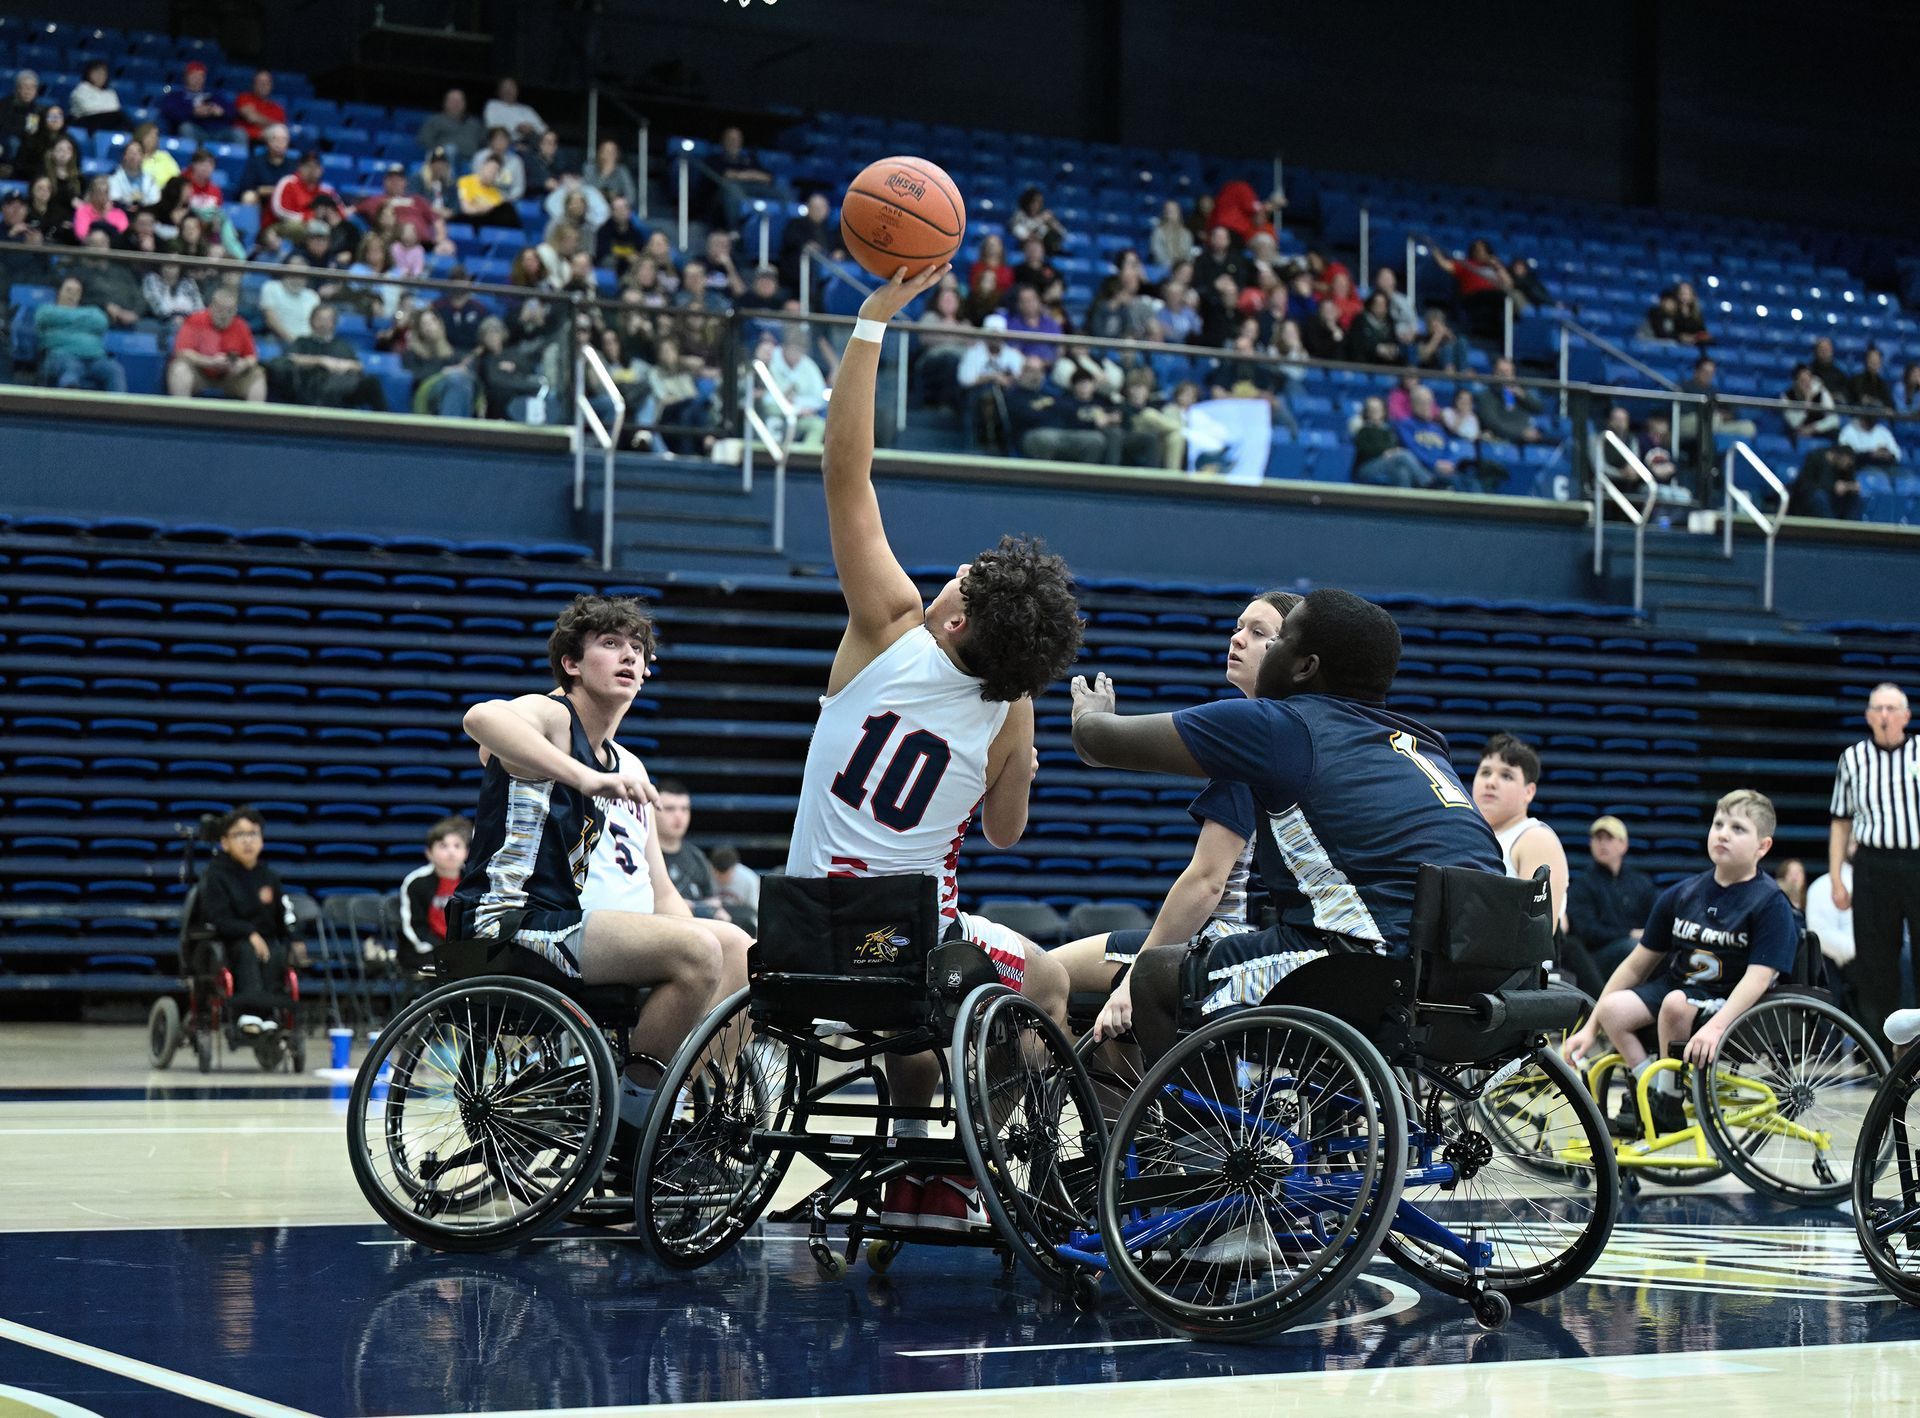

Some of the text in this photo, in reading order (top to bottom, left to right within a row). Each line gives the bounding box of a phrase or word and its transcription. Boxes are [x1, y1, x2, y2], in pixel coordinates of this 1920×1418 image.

[888, 175, 923, 198] OHSAA
[830, 710, 952, 833] 10
[1390, 730, 1473, 809] 1
[608, 821, 638, 876] 5
[1700, 927, 1748, 948] DEVILS
[1683, 948, 1723, 985] 2
